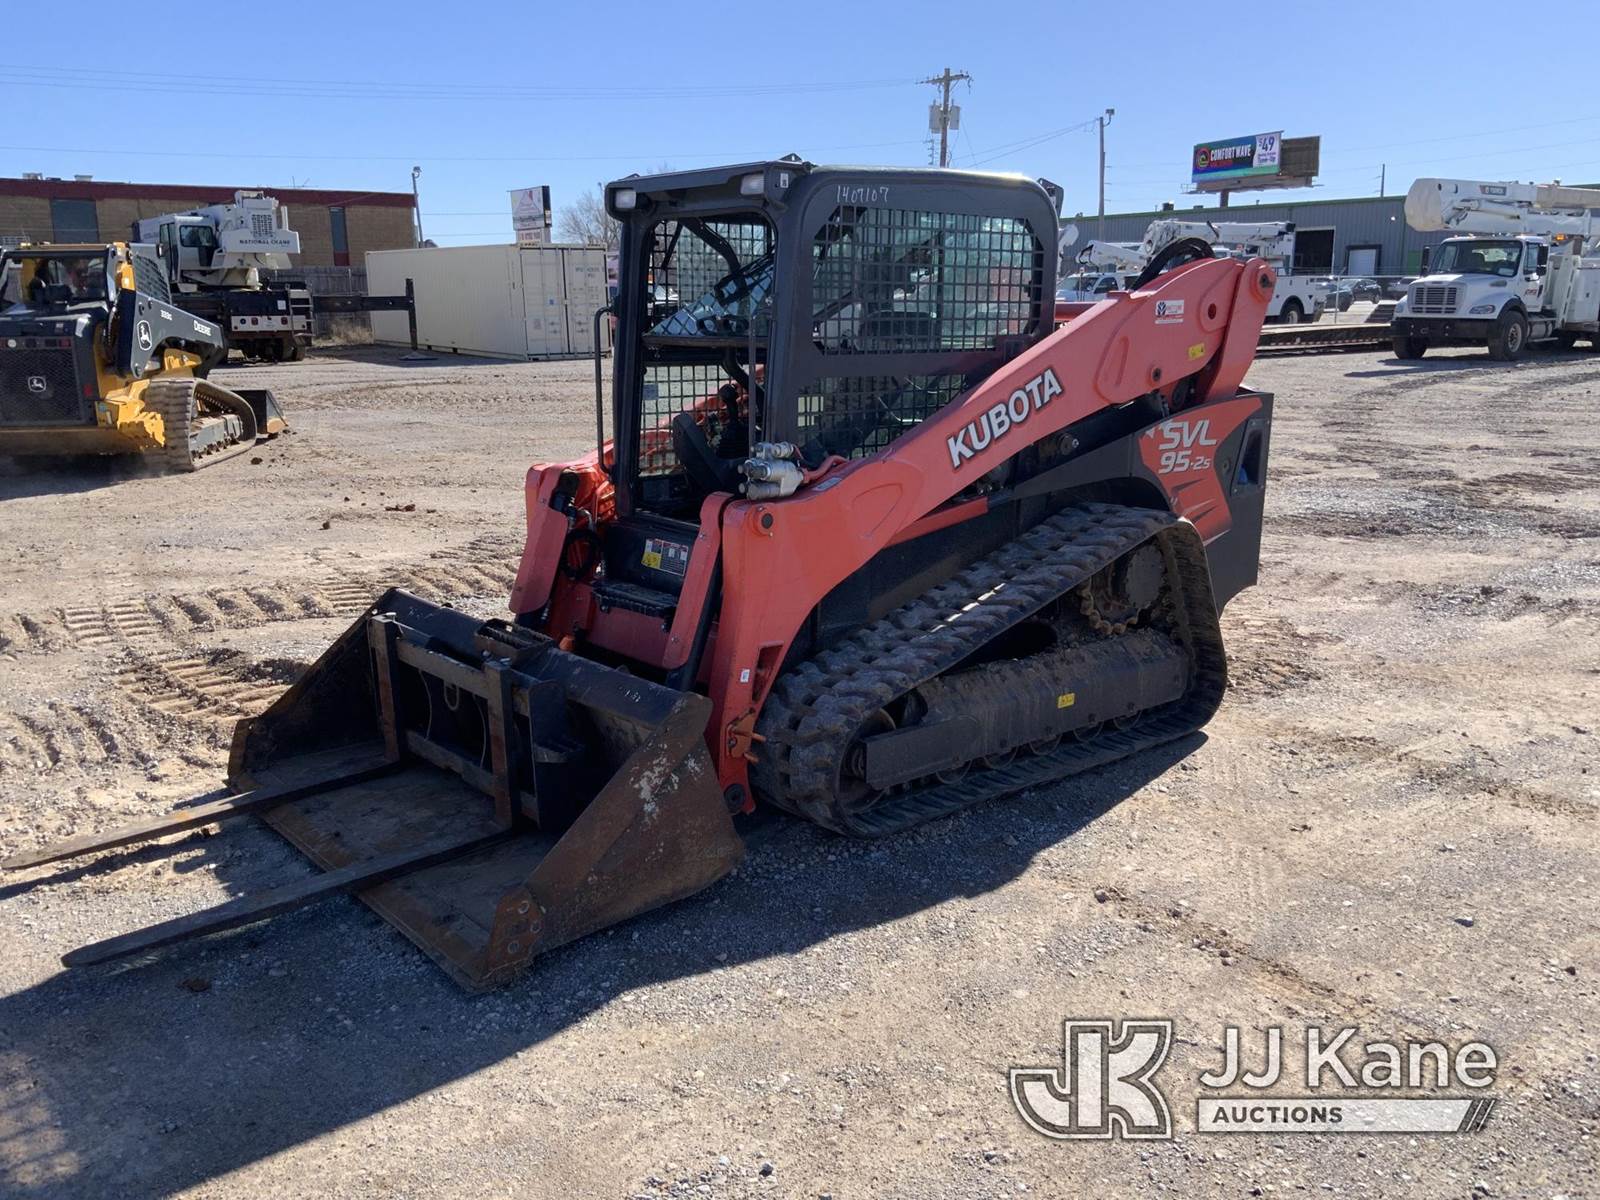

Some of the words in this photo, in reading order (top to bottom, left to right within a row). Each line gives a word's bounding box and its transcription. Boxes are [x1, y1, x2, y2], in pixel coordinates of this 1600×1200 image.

[836, 185, 889, 203] 1407107
[193, 319, 212, 337] DEERE
[947, 368, 1063, 468] KUBOTA
[1158, 419, 1217, 450] SVL
